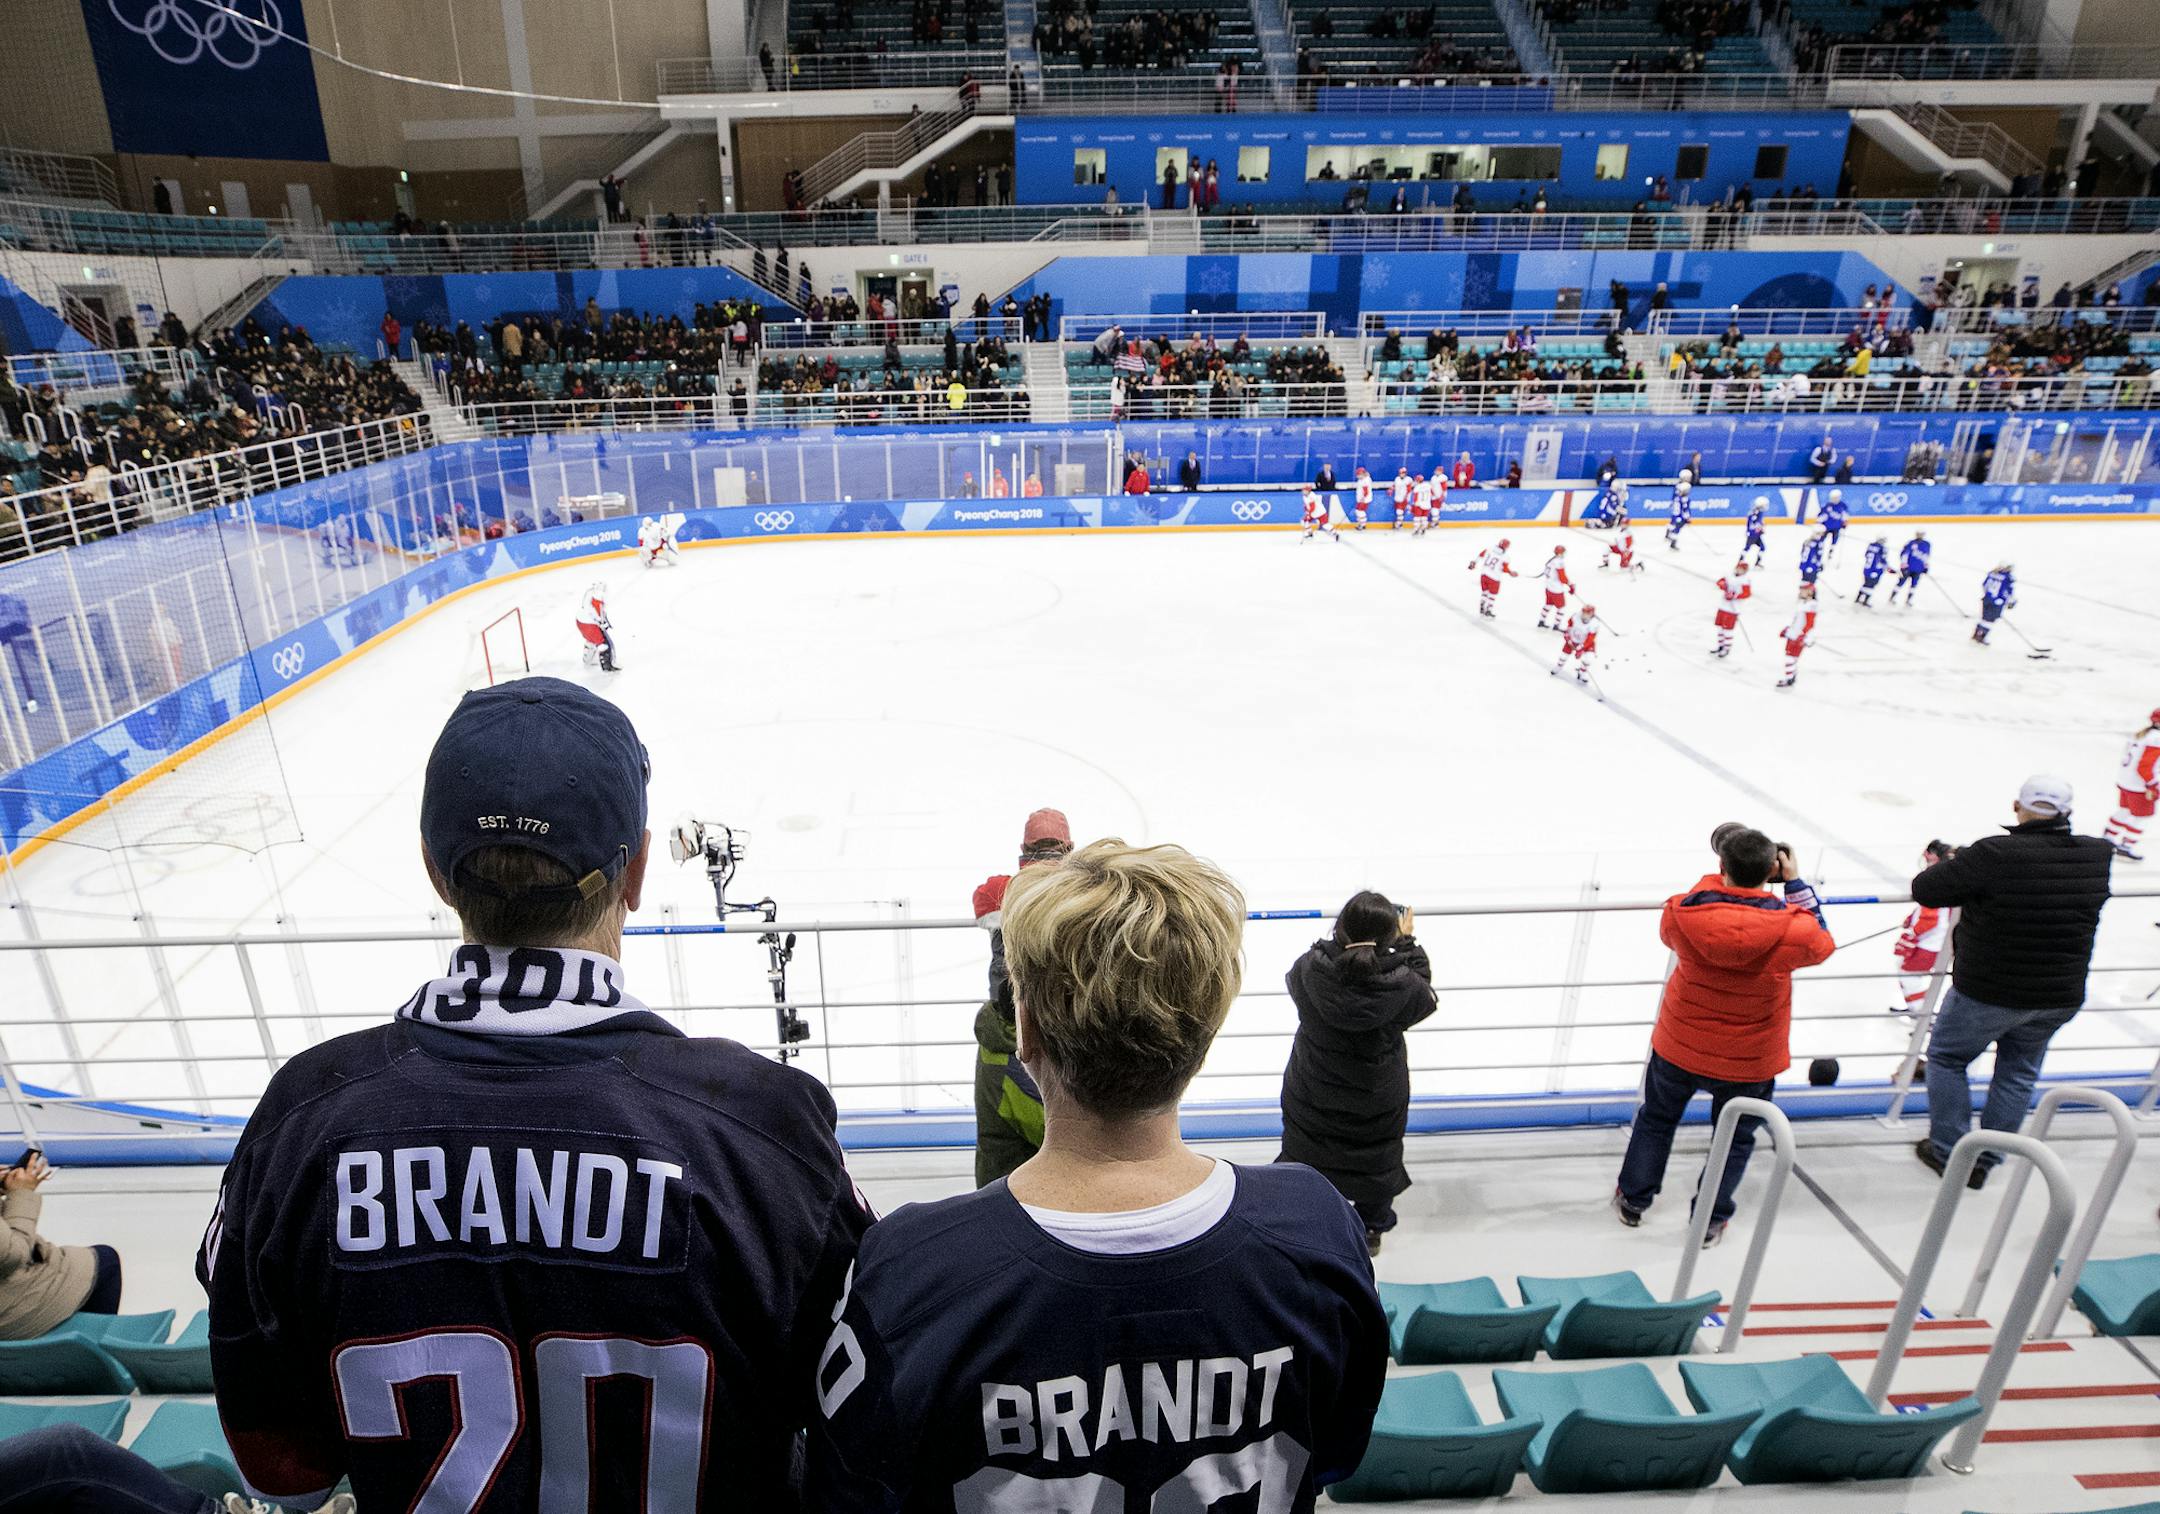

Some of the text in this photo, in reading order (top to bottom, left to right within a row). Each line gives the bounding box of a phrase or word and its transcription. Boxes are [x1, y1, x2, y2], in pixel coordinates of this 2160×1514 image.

[539, 530, 621, 554] PyeongChang 2018
[954, 508, 1043, 521] PyeongChang 2018
[477, 816, 550, 834] EST. 1776
[335, 1146, 682, 1258] BRANDT
[332, 1326, 714, 1514] 20
[981, 1346, 1294, 1461] BRANDT
